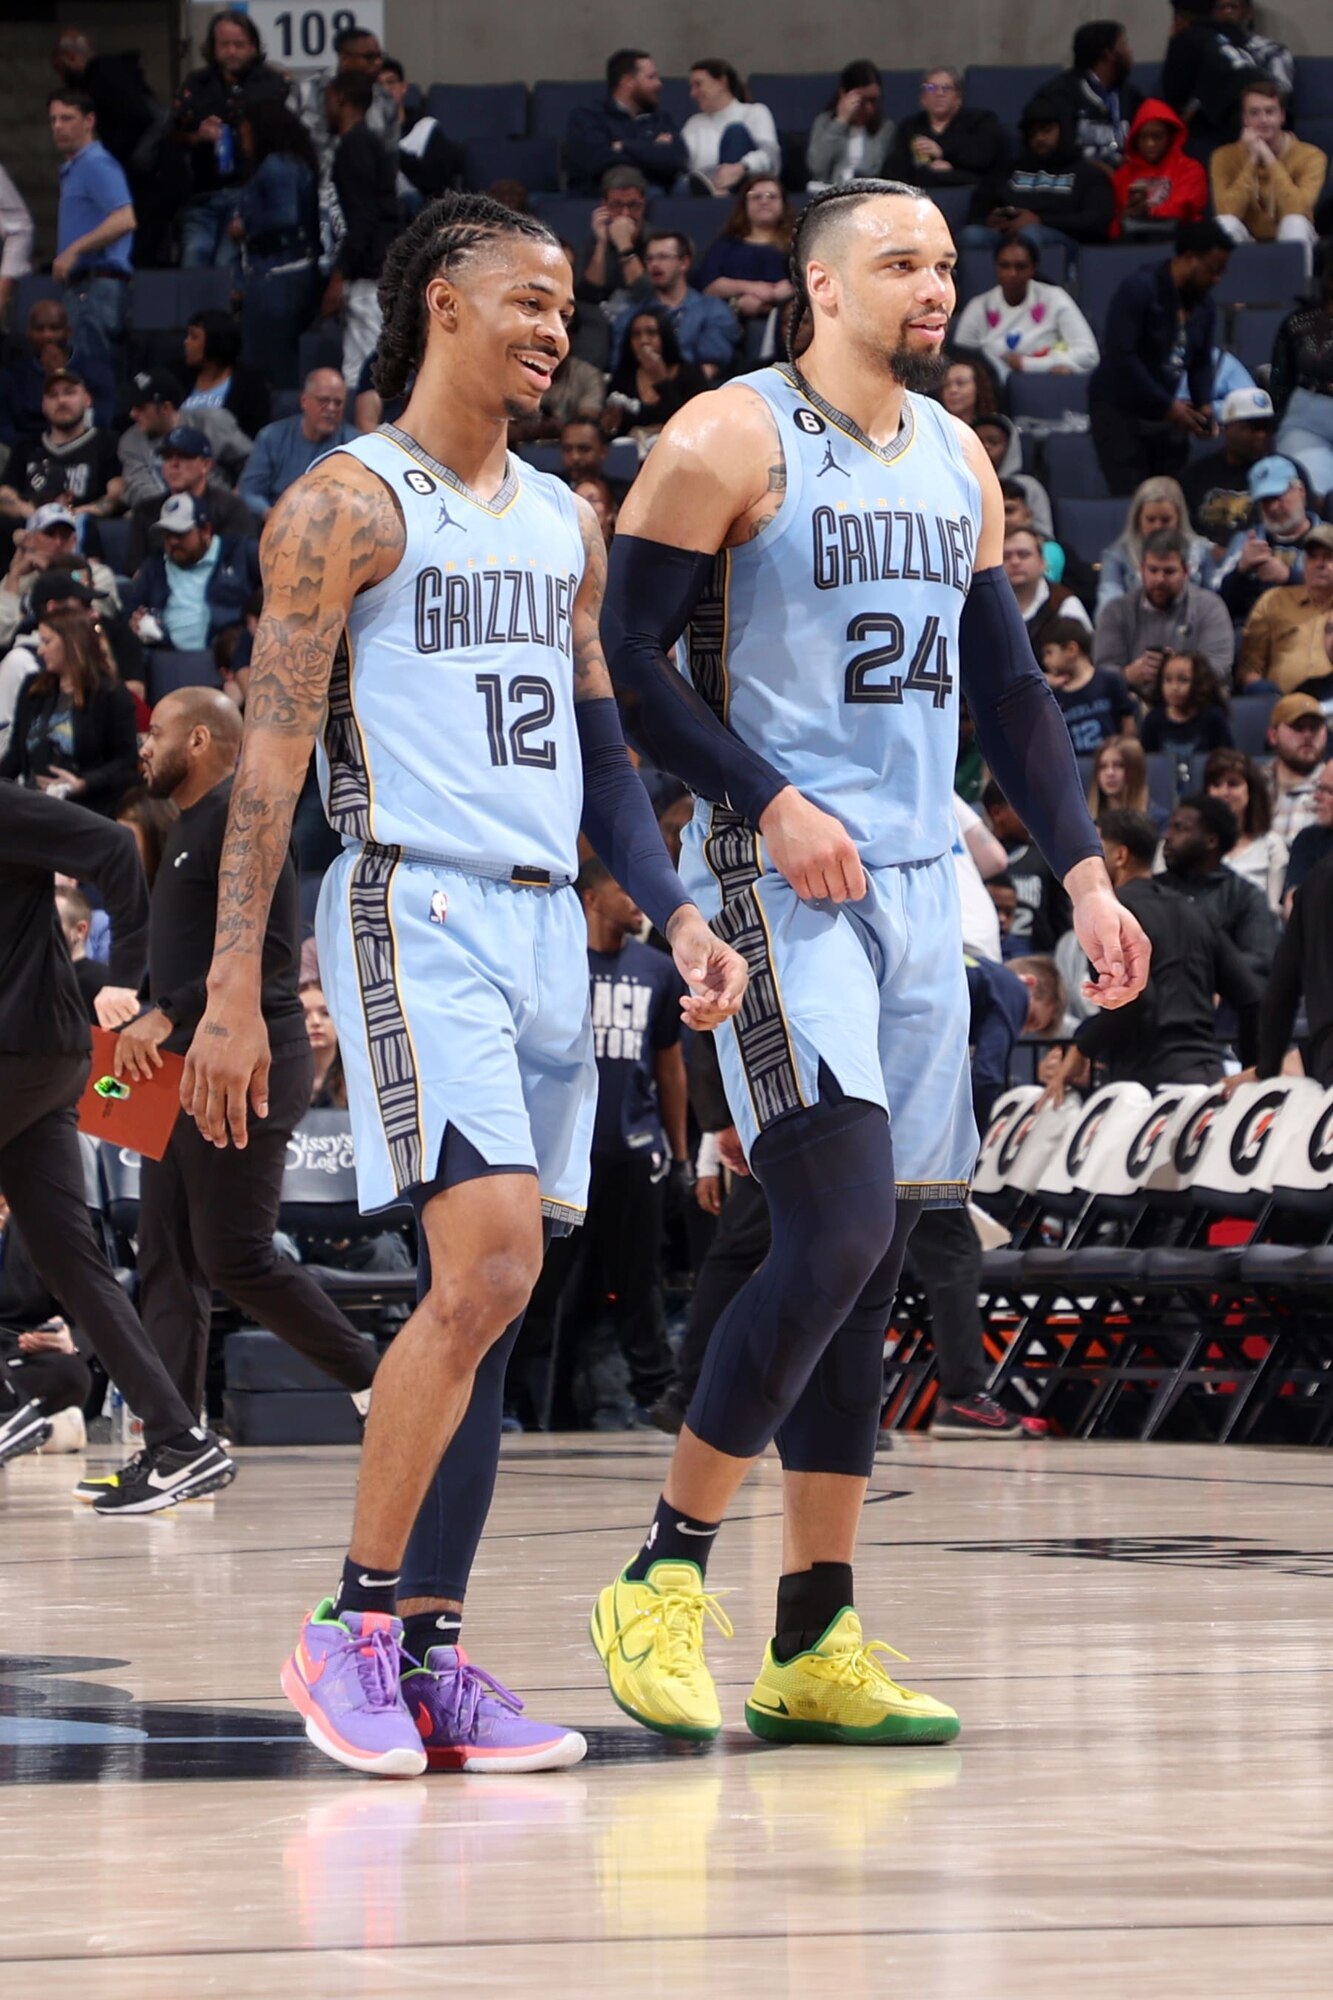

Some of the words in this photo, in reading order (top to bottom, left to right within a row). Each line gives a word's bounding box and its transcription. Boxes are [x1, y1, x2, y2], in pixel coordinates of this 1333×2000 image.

[799, 410, 821, 433] 6
[406, 471, 431, 494] 6
[844, 612, 953, 709] 24
[475, 673, 557, 770] 12
[592, 981, 652, 1031] ACK
[1230, 1089, 1291, 1176] G
